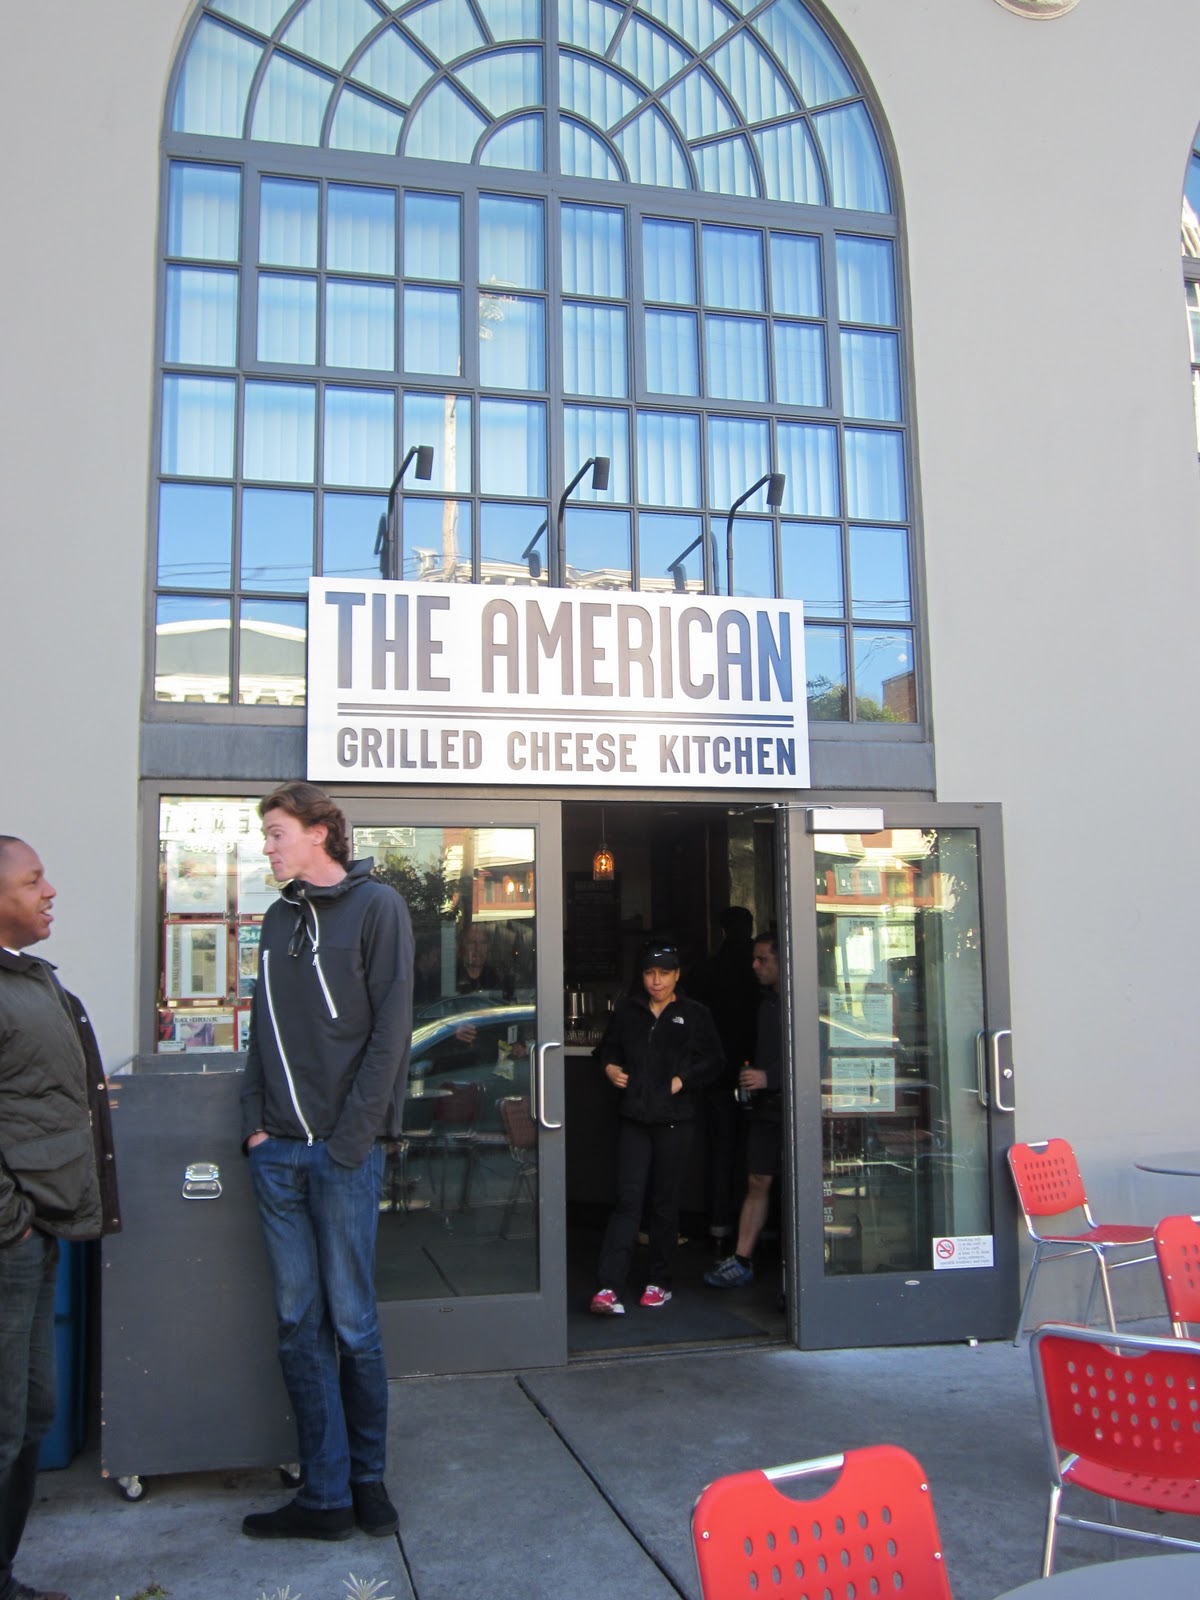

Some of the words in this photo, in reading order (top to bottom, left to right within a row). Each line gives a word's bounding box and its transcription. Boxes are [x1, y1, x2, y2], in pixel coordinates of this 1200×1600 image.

[325, 591, 451, 692] THE
[481, 598, 794, 702] AMERICAN
[336, 727, 483, 769] GRILLED
[507, 730, 637, 773] CHEESE
[659, 734, 797, 775] KITCHEN
